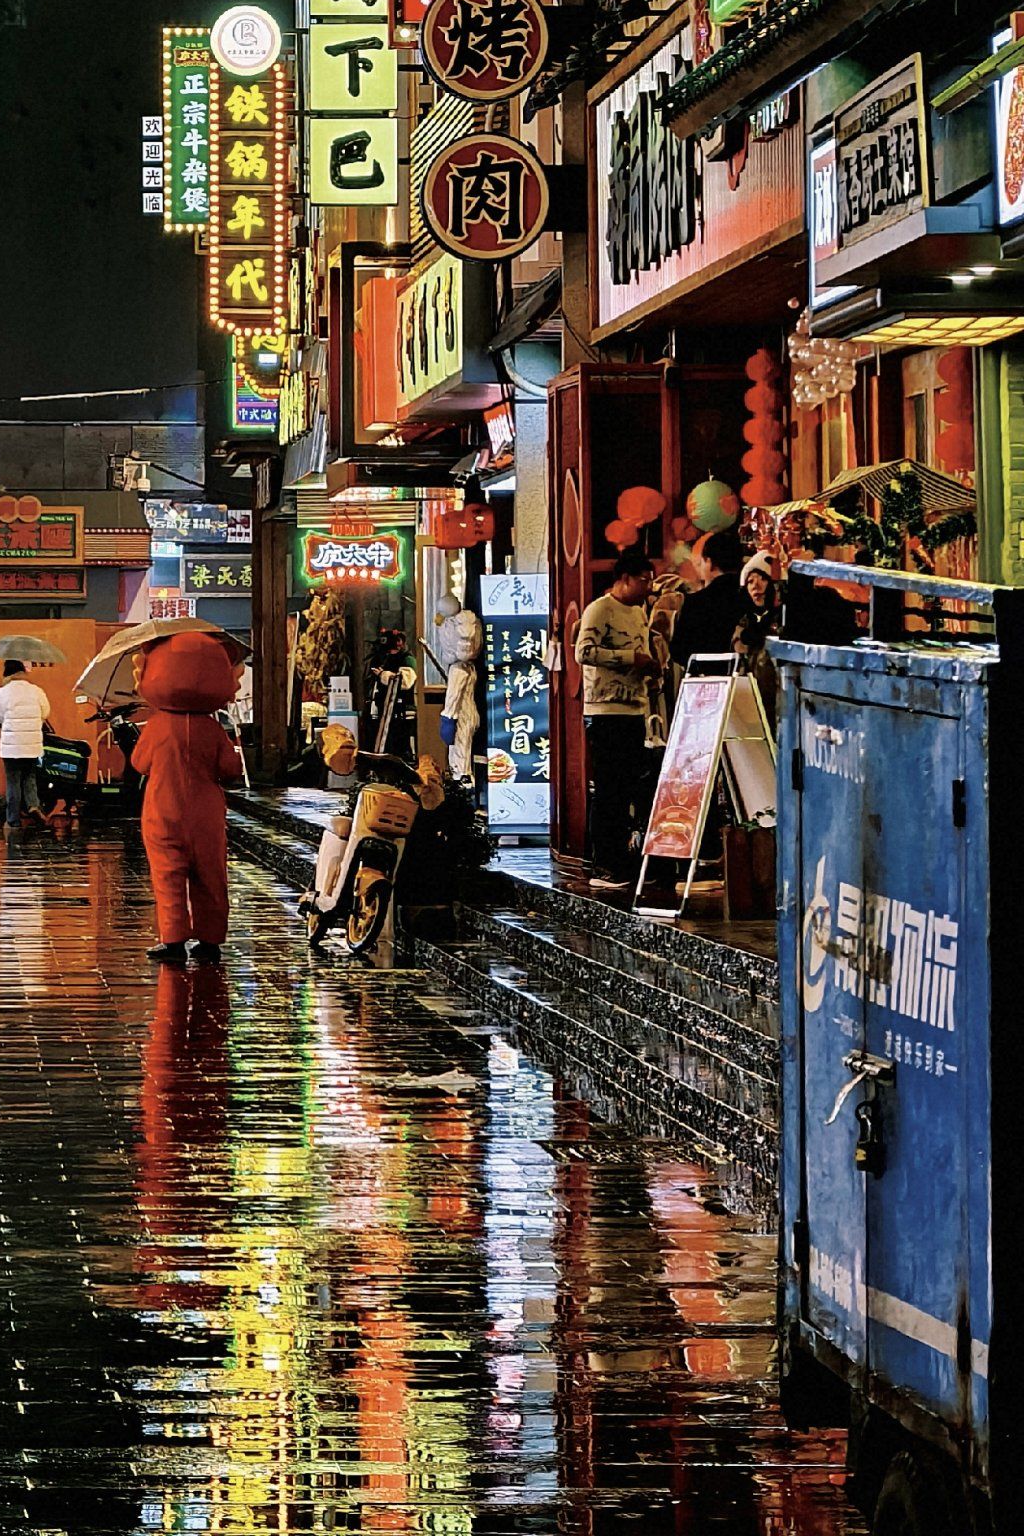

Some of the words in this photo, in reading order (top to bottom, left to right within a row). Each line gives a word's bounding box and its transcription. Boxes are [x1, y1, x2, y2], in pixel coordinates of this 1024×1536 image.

[144, 118, 163, 212] 欢迎光临
[179, 73, 209, 214] 正宗牛杂煲
[225, 83, 271, 303] 铁锅年代
